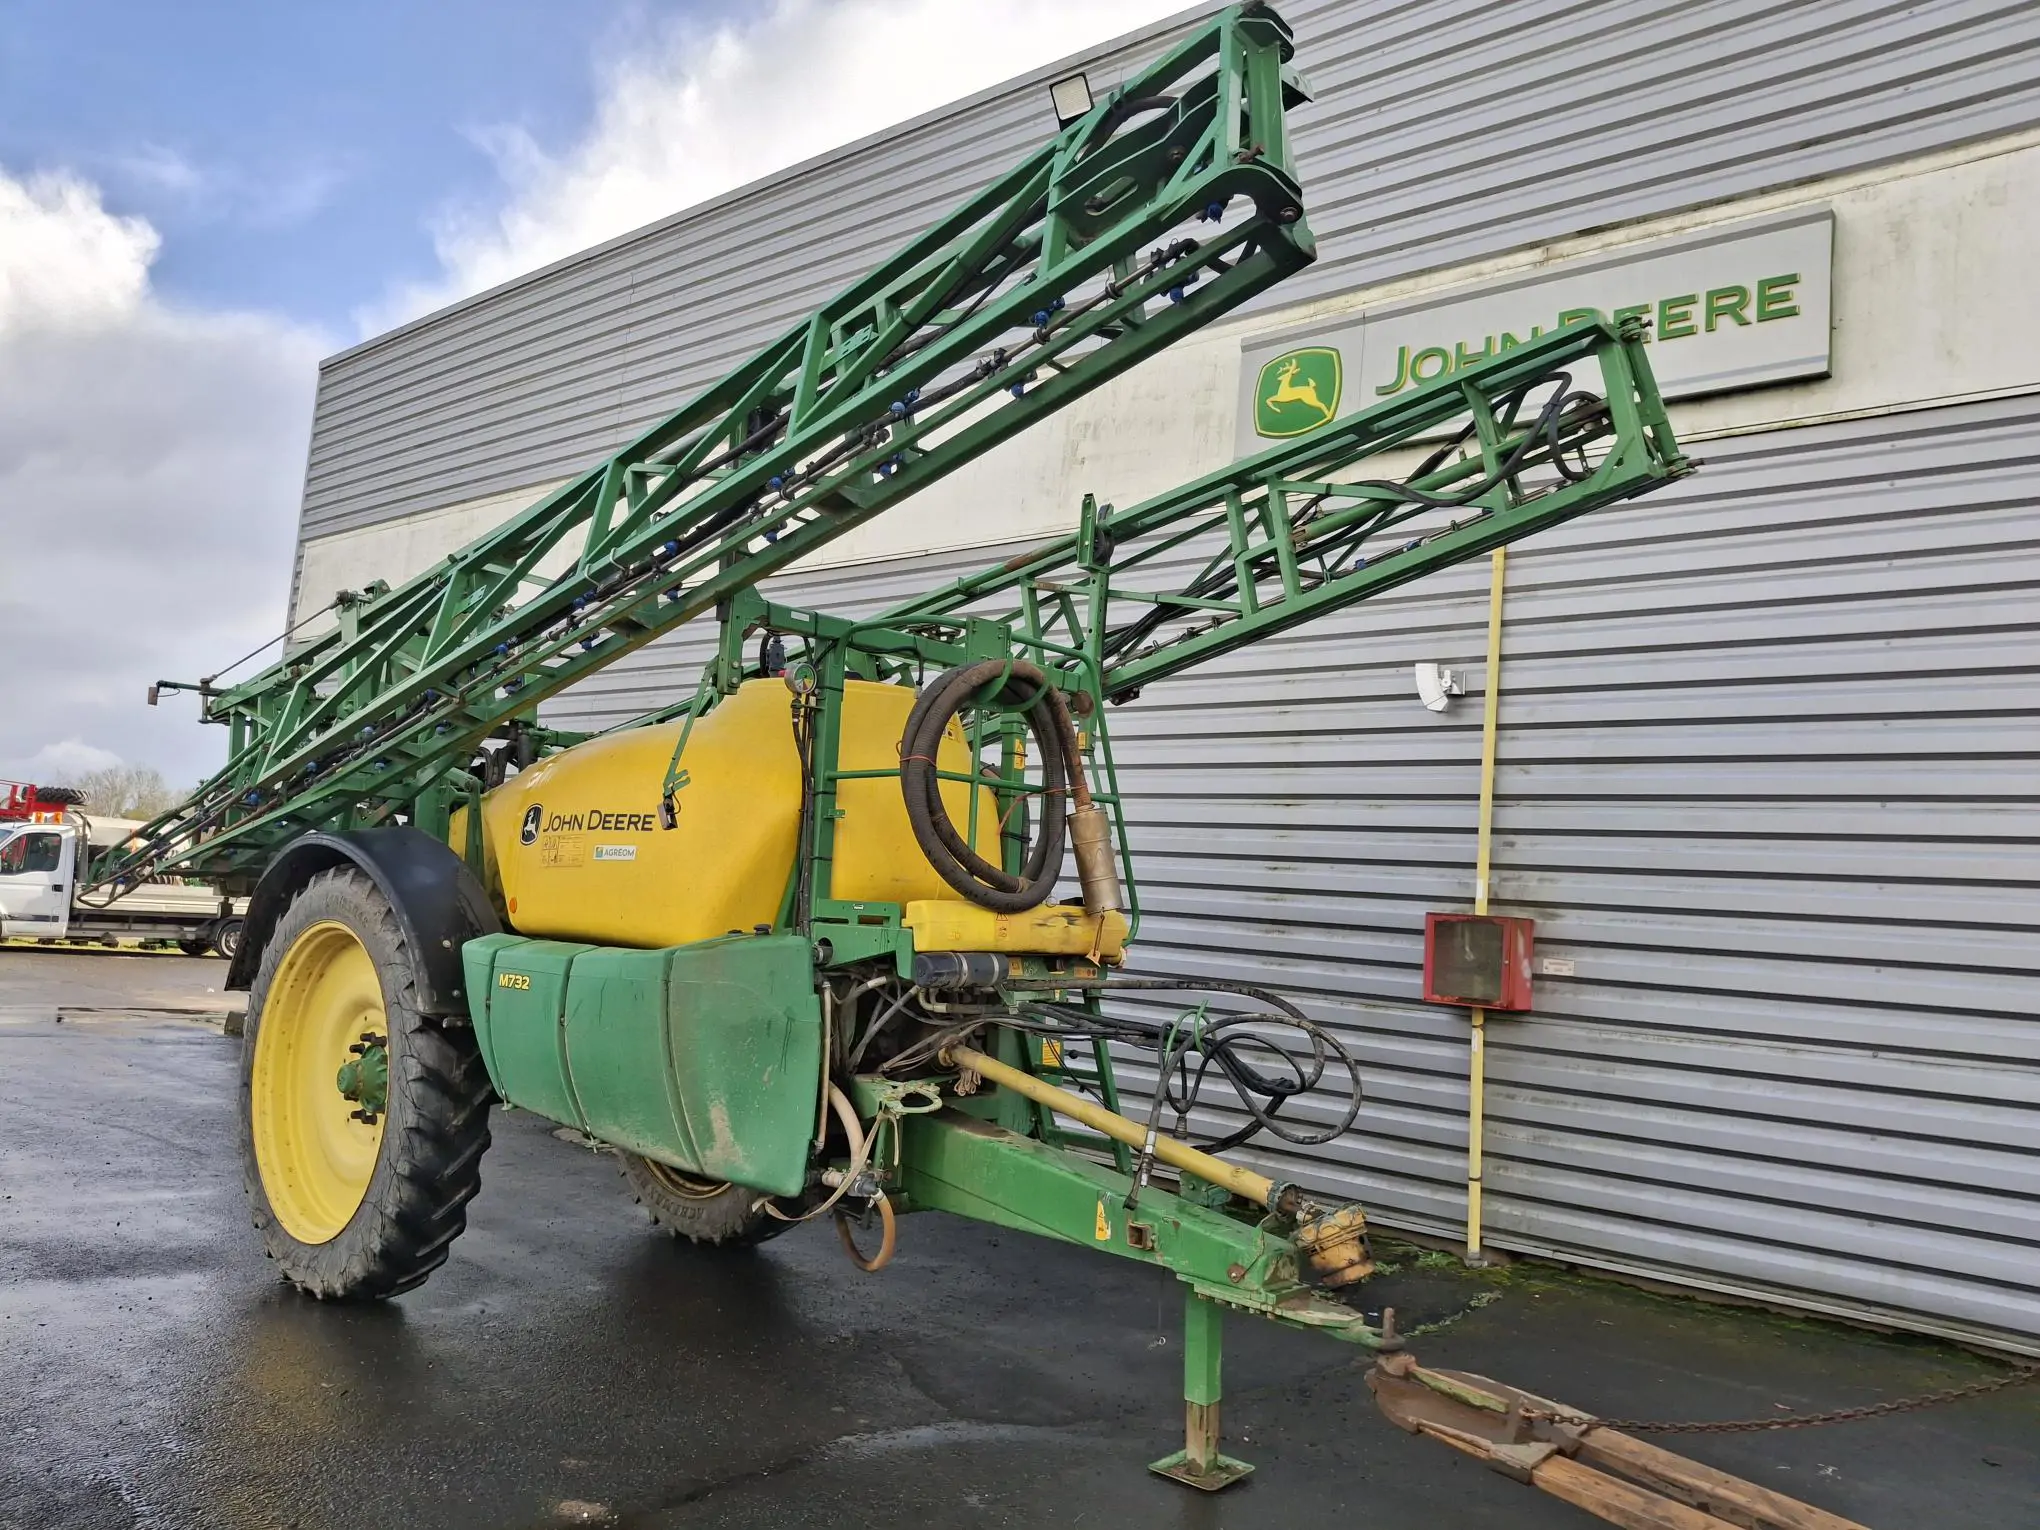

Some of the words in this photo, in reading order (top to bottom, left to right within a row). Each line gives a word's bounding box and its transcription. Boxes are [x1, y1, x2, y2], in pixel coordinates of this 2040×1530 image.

[542, 812, 584, 832] JOHN
[587, 809, 656, 831] DEERE
[499, 973, 530, 990] M732
